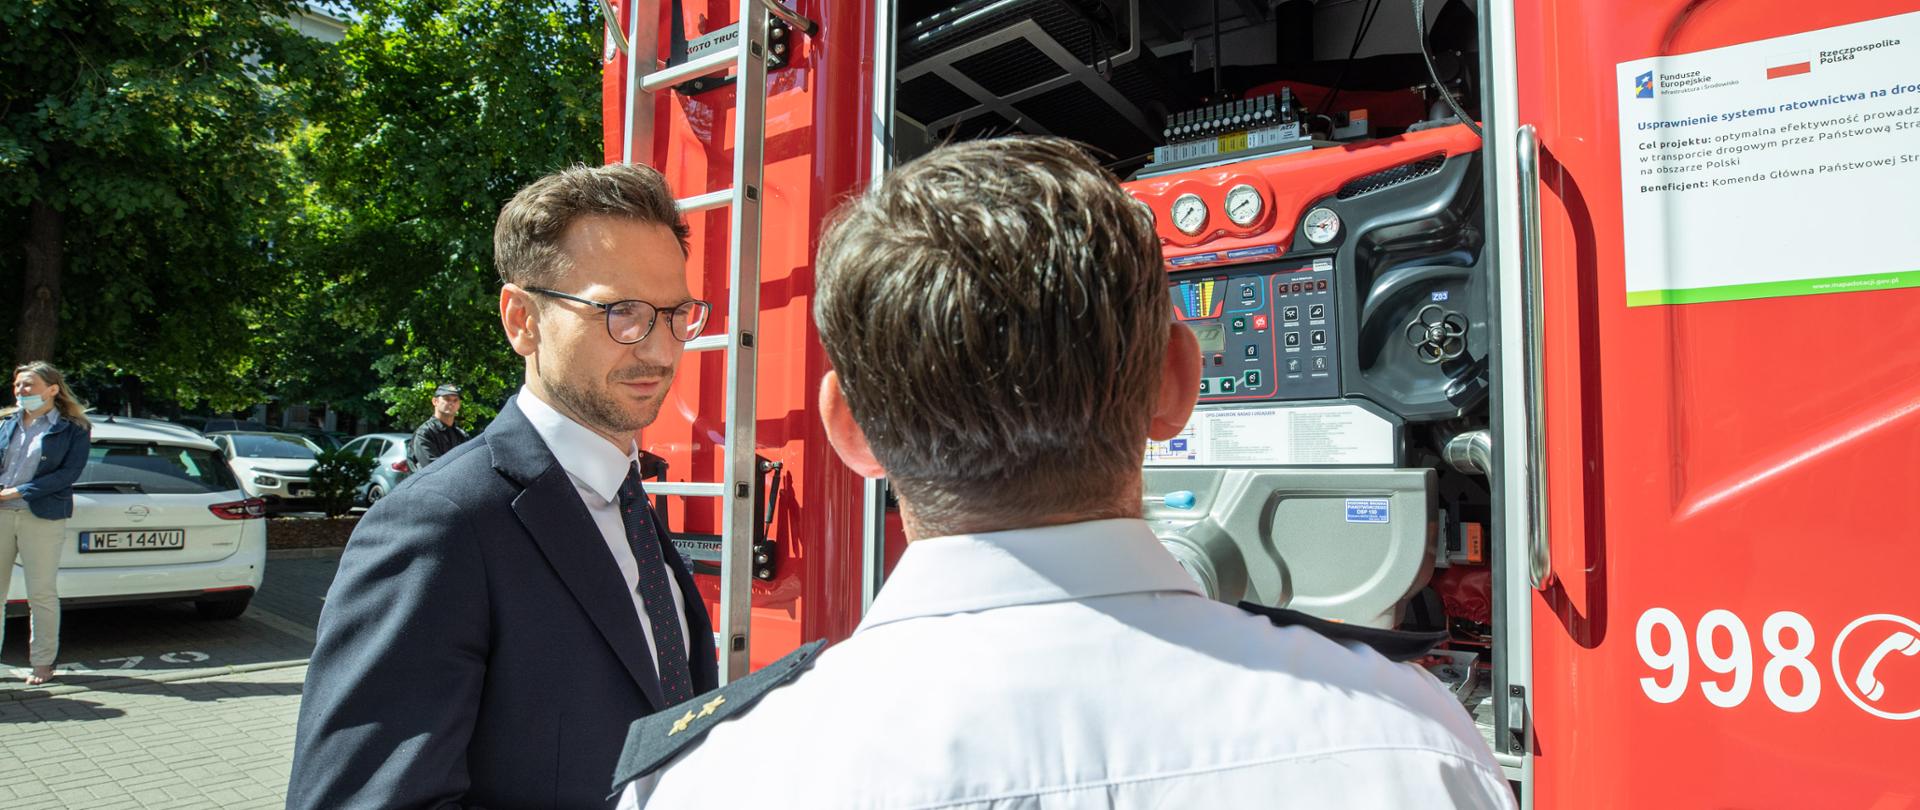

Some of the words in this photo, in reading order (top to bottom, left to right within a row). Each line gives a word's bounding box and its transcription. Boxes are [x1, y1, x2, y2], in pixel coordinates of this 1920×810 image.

[713, 30, 738, 45] TRUC
[1819, 39, 1900, 58] Rzeczpospolita
[1820, 53, 1855, 65] Polska
[1660, 69, 1701, 81] Fundusze
[1660, 75, 1712, 88] Europejskie
[1637, 113, 1718, 131] Usprawnienie
[1721, 106, 1776, 122] systemu
[1779, 92, 1866, 112] ratownictwa
[1870, 89, 1887, 98] na
[1639, 141, 1656, 150] Cel
[1660, 136, 1711, 150] projektu:
[1714, 127, 1776, 143] optymalna
[1780, 114, 1859, 133] efektywność
[1652, 149, 1712, 162] transporcie
[1716, 140, 1777, 155] drogowym
[1781, 135, 1815, 147] przez
[1819, 125, 1891, 141] Państwową
[1895, 120, 1920, 130] Stra
[1640, 168, 1653, 176] na
[1656, 162, 1703, 174] obszarze
[1706, 157, 1740, 169] Polski
[1640, 181, 1709, 193] Beneficjent:
[1712, 173, 1766, 187] Komenda
[1769, 168, 1815, 179] Główna
[1819, 155, 1896, 173] Państwowej
[1900, 154, 1920, 163] Str
[94, 533, 118, 548] WE
[127, 532, 179, 547] 144VU
[697, 542, 721, 551] TRUC
[1635, 607, 1821, 713] 998
